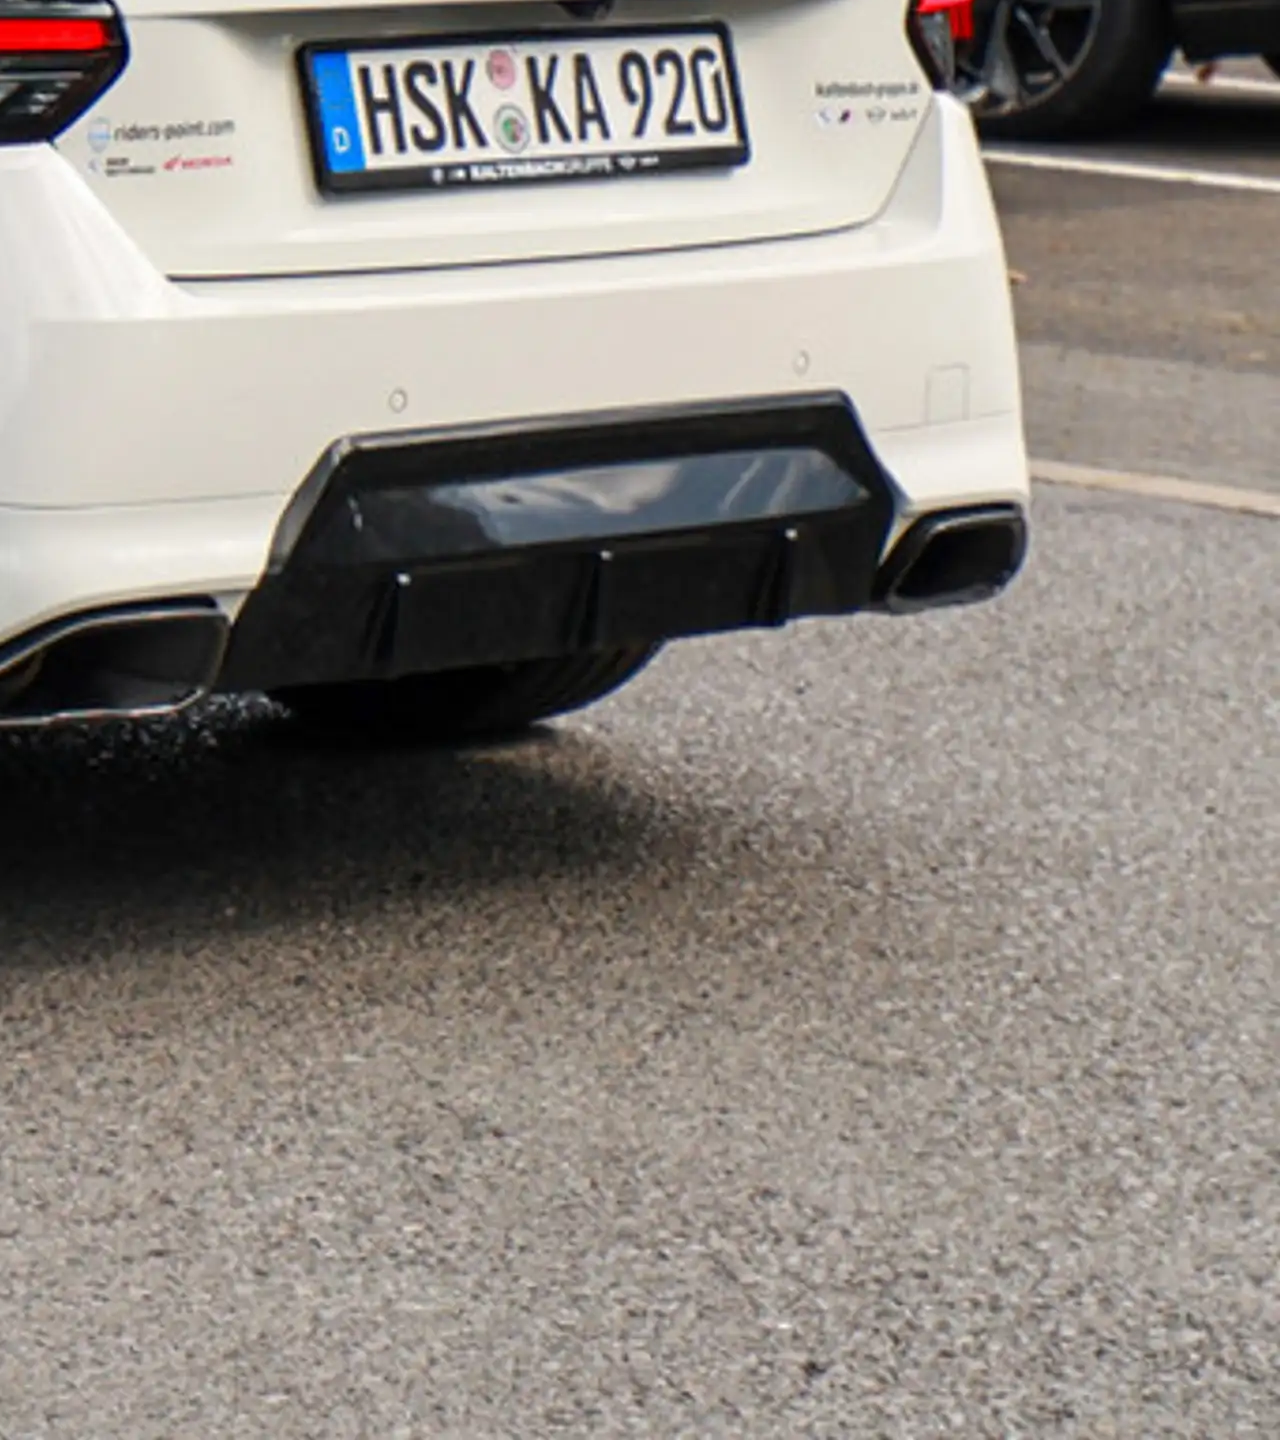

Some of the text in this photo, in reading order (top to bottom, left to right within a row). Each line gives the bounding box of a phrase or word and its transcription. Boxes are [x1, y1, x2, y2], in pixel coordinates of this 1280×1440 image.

[114, 119, 235, 142] riders-point.com
[357, 59, 489, 155] HSK
[527, 53, 611, 144] KA
[618, 47, 730, 138] 920
